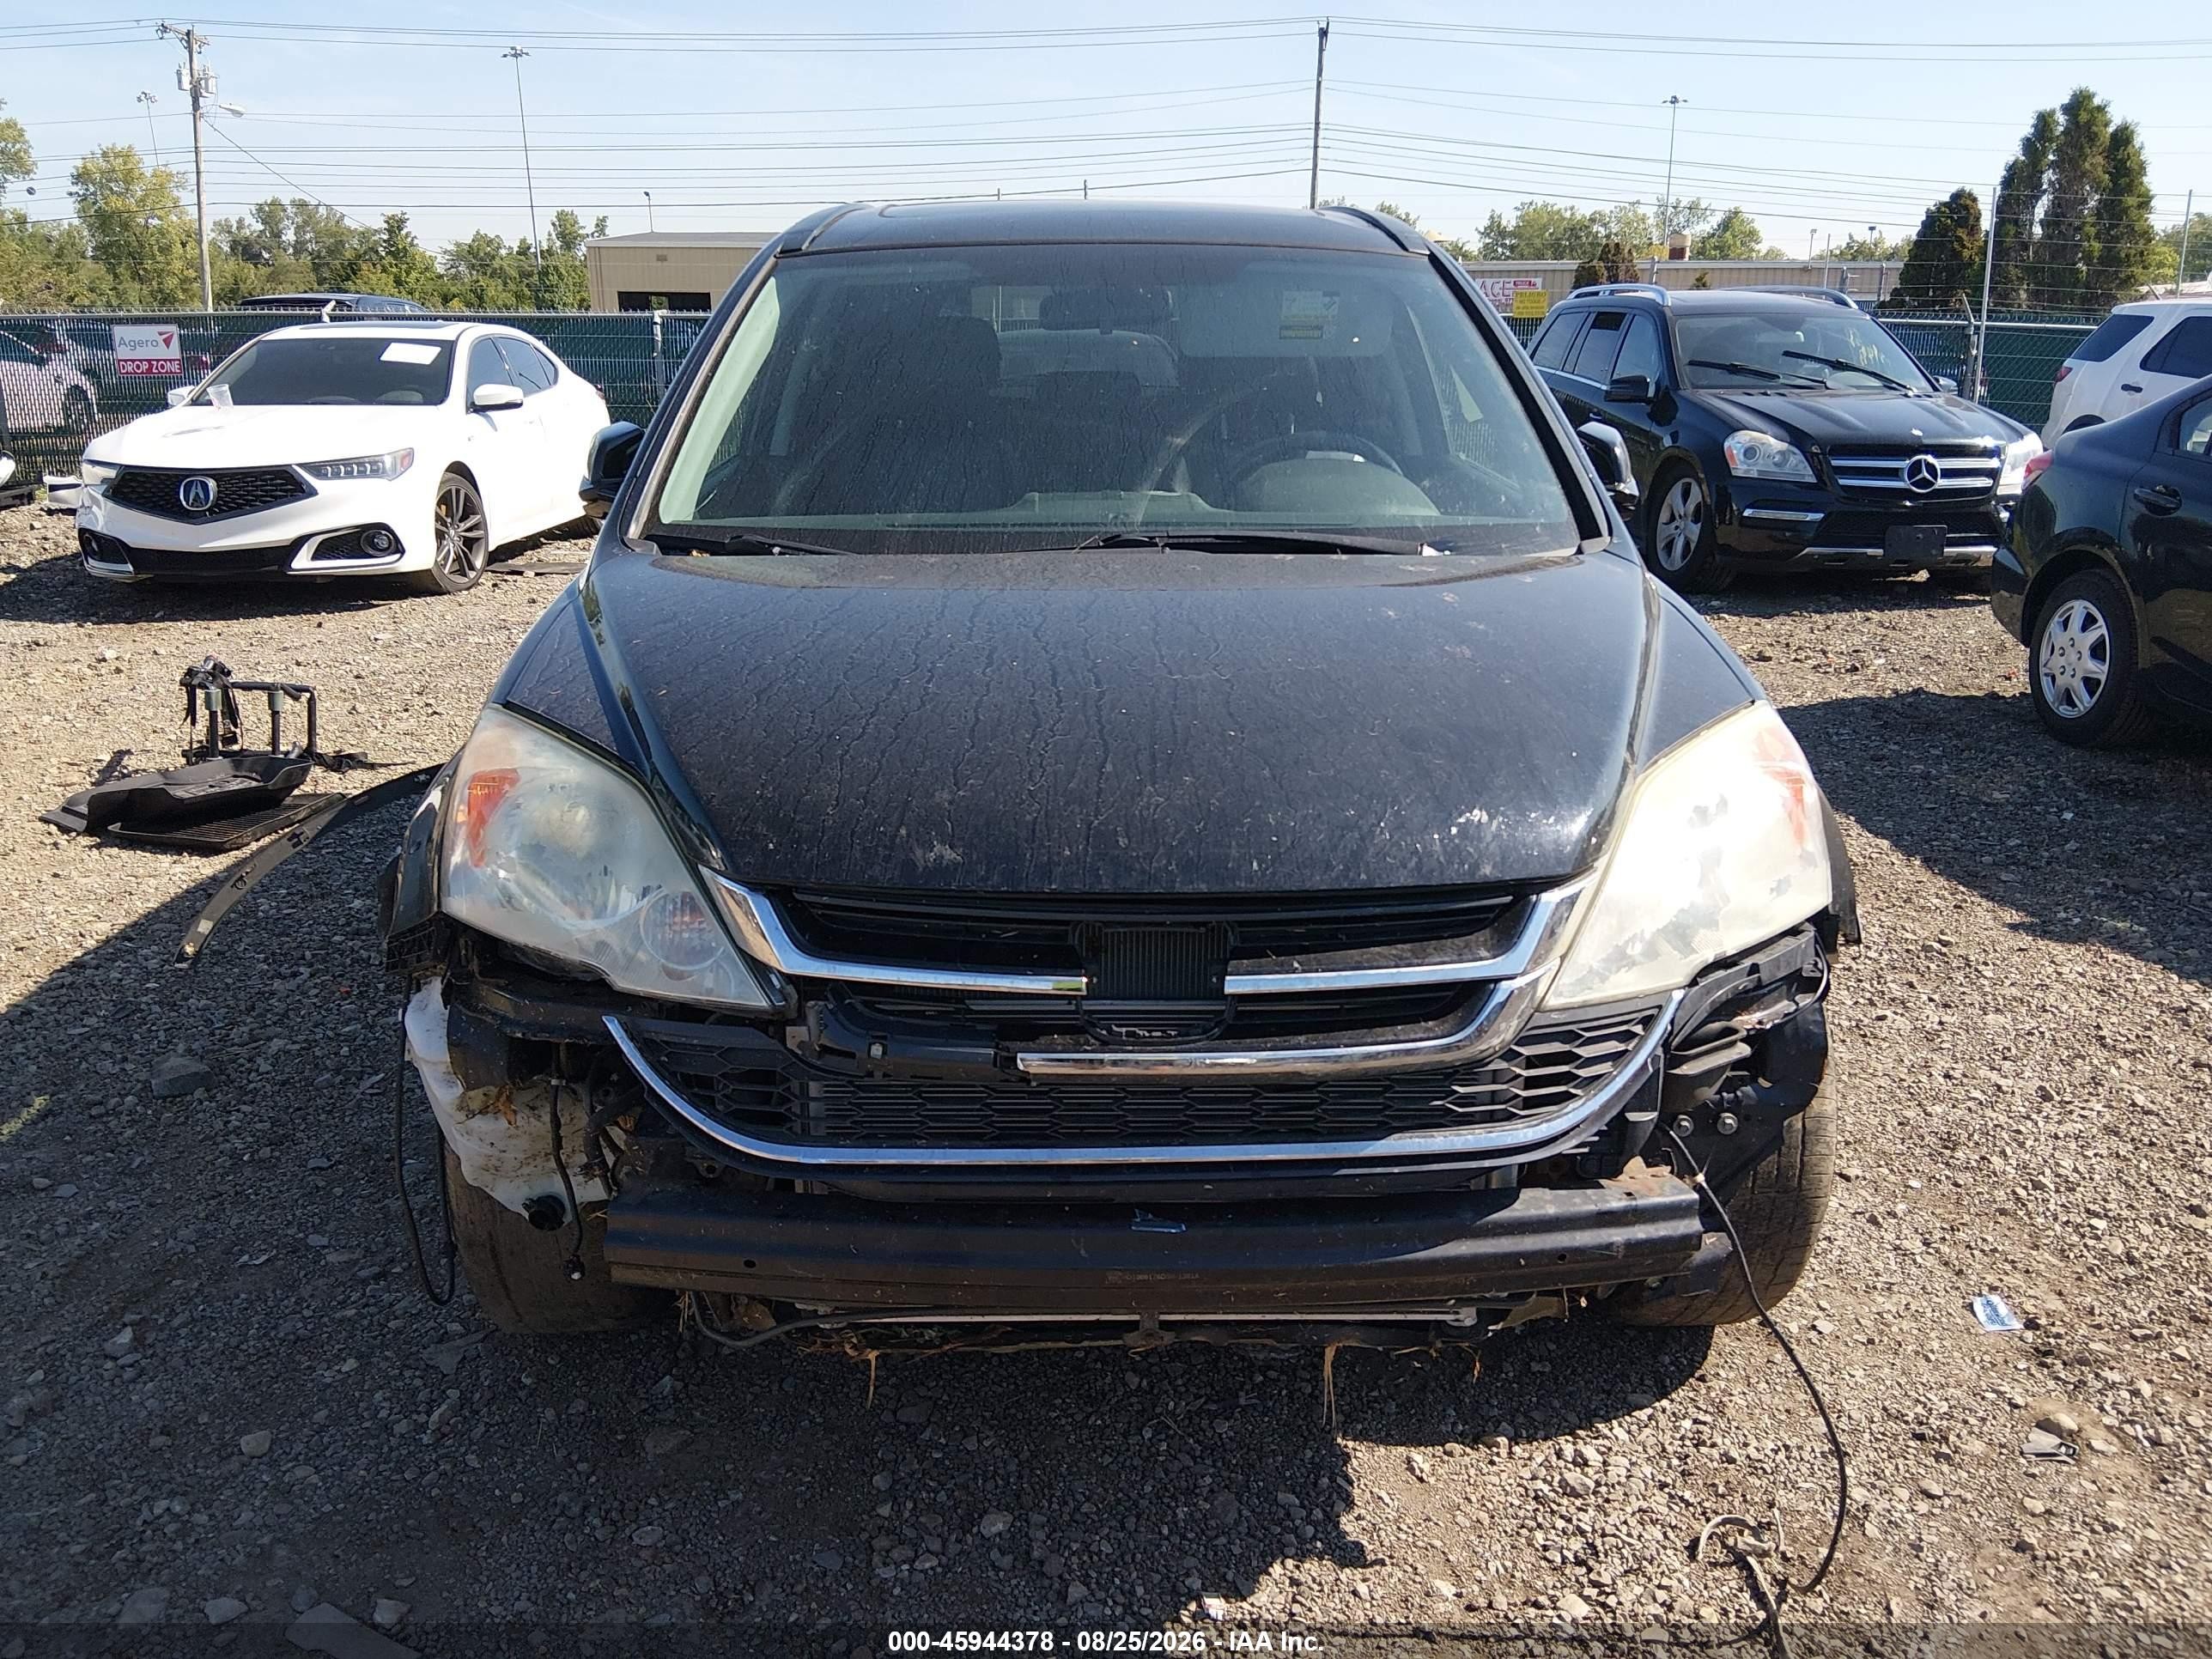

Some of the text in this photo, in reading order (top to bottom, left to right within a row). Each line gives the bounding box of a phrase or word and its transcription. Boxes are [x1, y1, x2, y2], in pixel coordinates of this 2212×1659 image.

[118, 336, 159, 351] Agero
[119, 361, 181, 374] DROP ZONE
